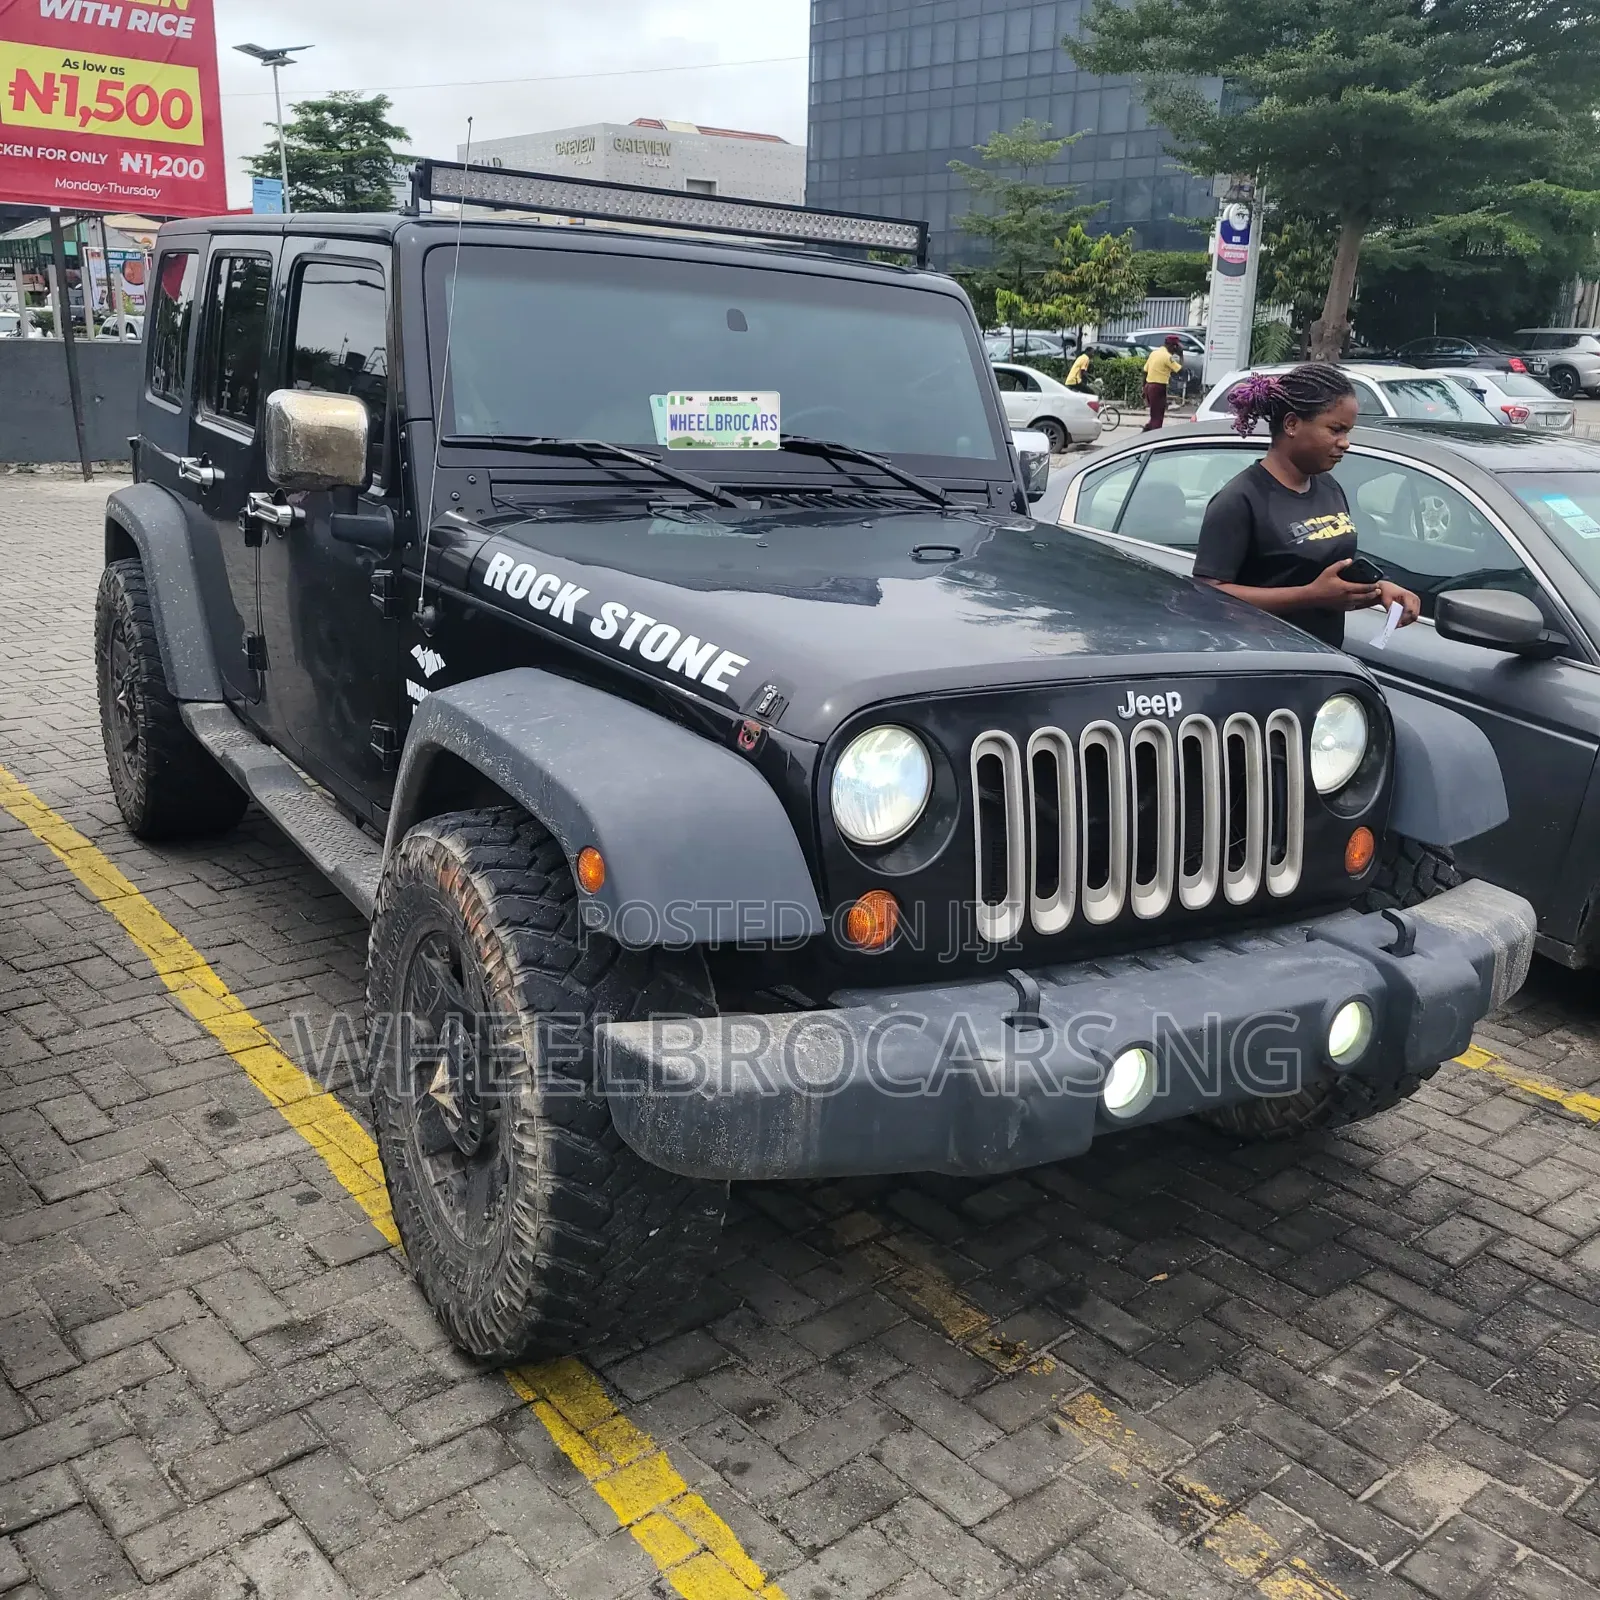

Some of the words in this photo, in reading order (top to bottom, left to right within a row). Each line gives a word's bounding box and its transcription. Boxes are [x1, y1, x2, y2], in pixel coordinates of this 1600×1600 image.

[38, 0, 122, 28] WITH
[127, 9, 195, 39] RICE
[61, 58, 79, 70] As
[83, 60, 107, 73] low
[110, 65, 125, 76] as
[37, 147, 66, 161] FOR
[70, 151, 109, 165] ONLY
[613, 137, 671, 156] GATEVIEW
[55, 177, 161, 199] Monday-Thursday
[669, 413, 778, 432] WHEELBROCARS
[483, 551, 590, 625] ROCK
[590, 601, 750, 693] STONE
[1117, 690, 1182, 719] Jeep
